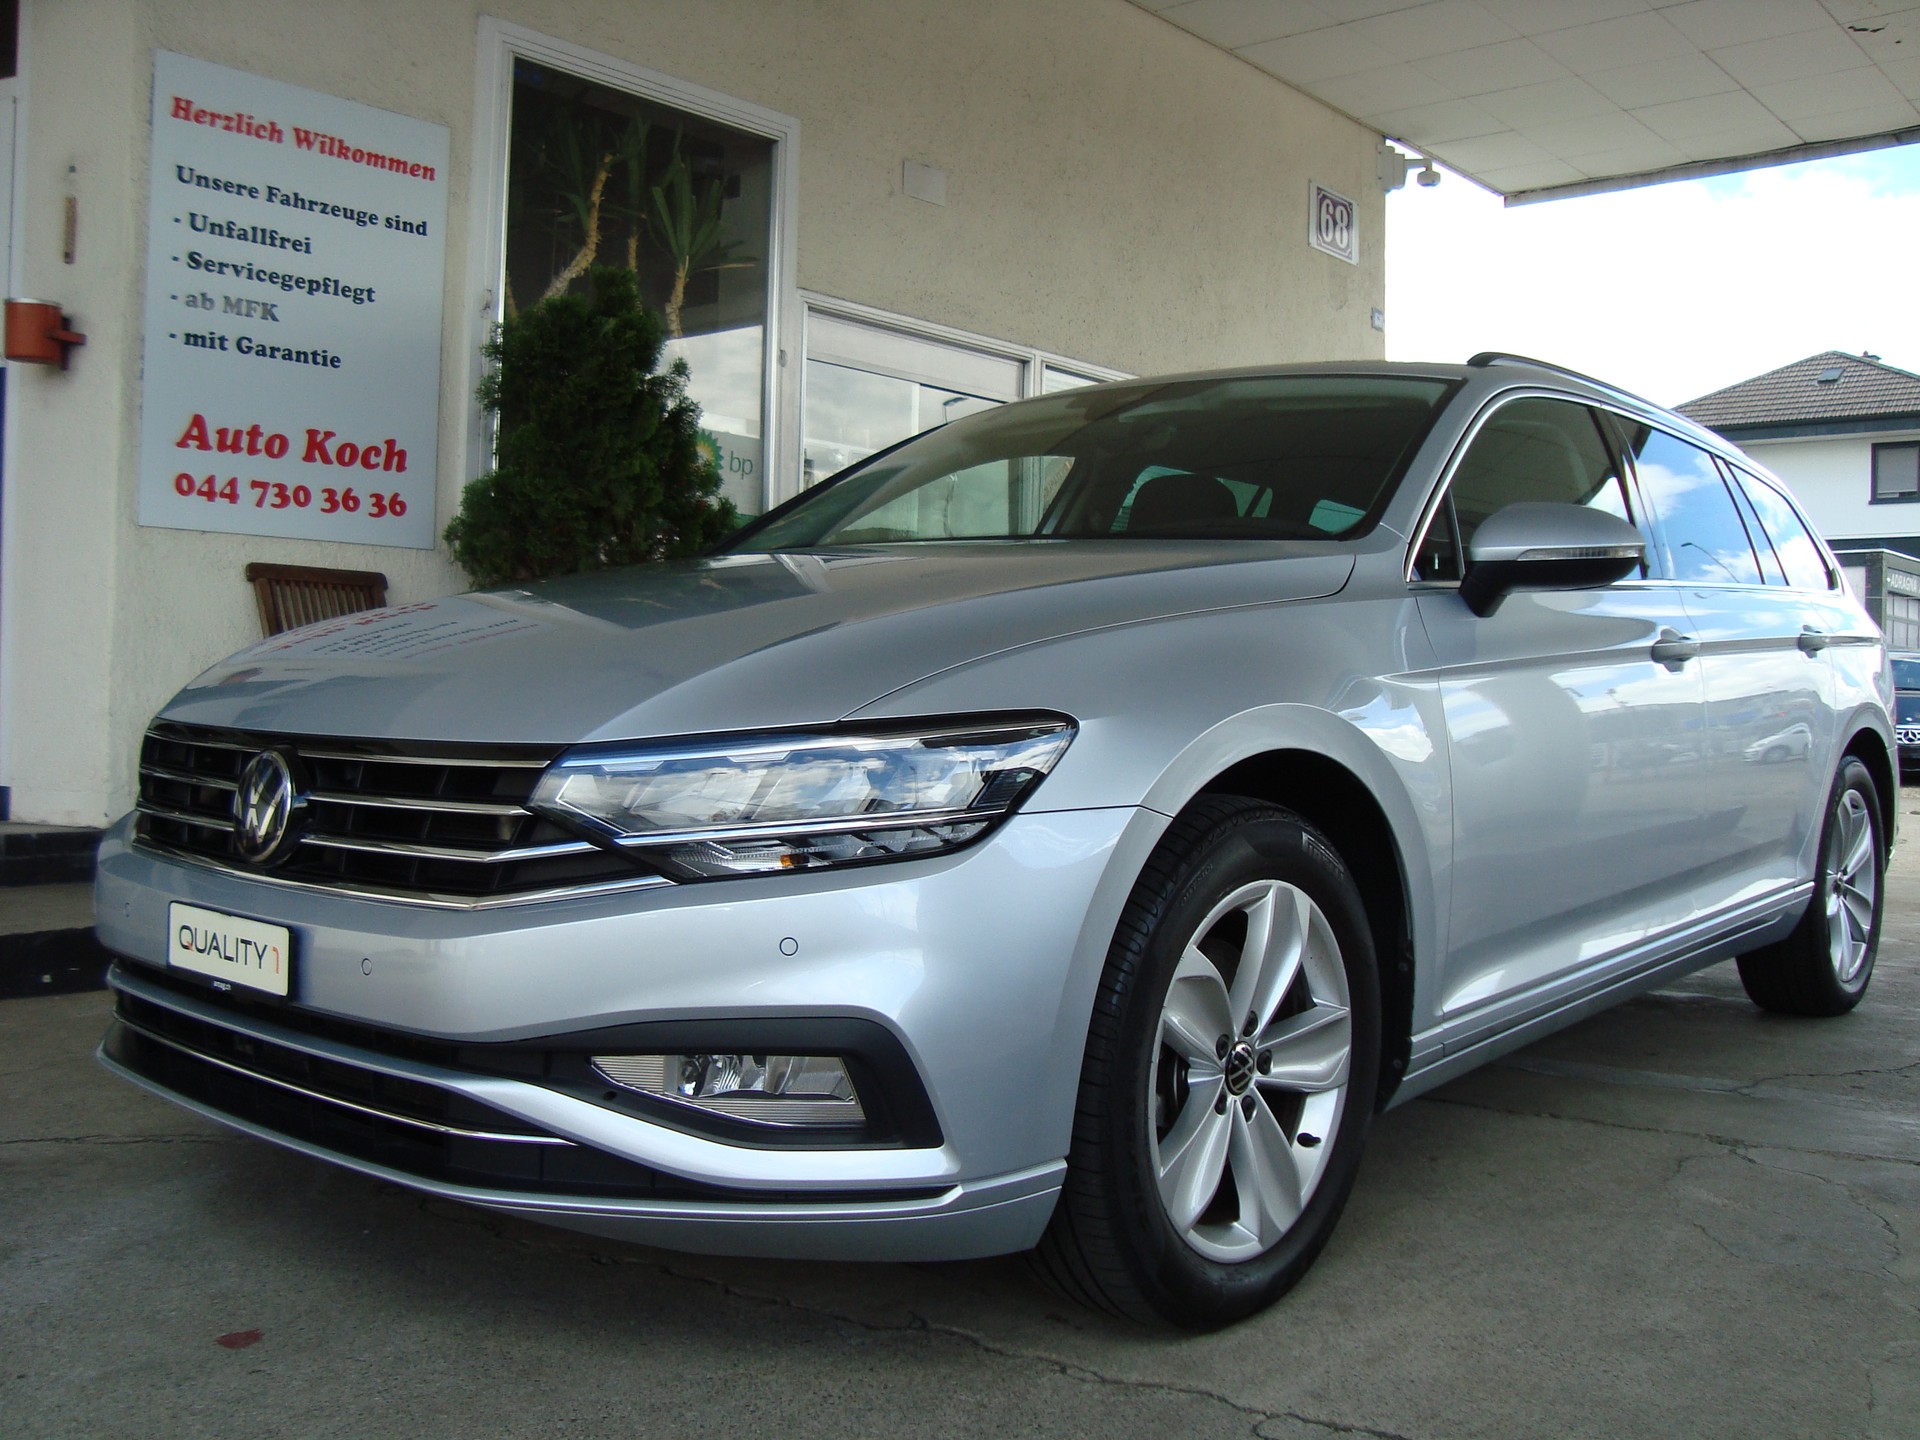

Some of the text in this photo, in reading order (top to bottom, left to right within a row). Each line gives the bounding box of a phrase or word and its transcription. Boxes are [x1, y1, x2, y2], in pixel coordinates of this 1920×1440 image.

[171, 96, 436, 181] Herzlich Wilkommen
[176, 165, 428, 237] Unsere Fahrzeuge sind
[1321, 199, 1348, 249] 68
[188, 212, 312, 254] Unfallfrei
[187, 251, 376, 305] Servicegepflegt
[185, 293, 216, 312] ab
[223, 295, 280, 322] MFK
[184, 331, 228, 352] mit
[236, 336, 342, 369] Garantie
[176, 413, 408, 473] Auto Koch
[729, 450, 754, 480] bp
[175, 473, 408, 518] 044 730 36 36
